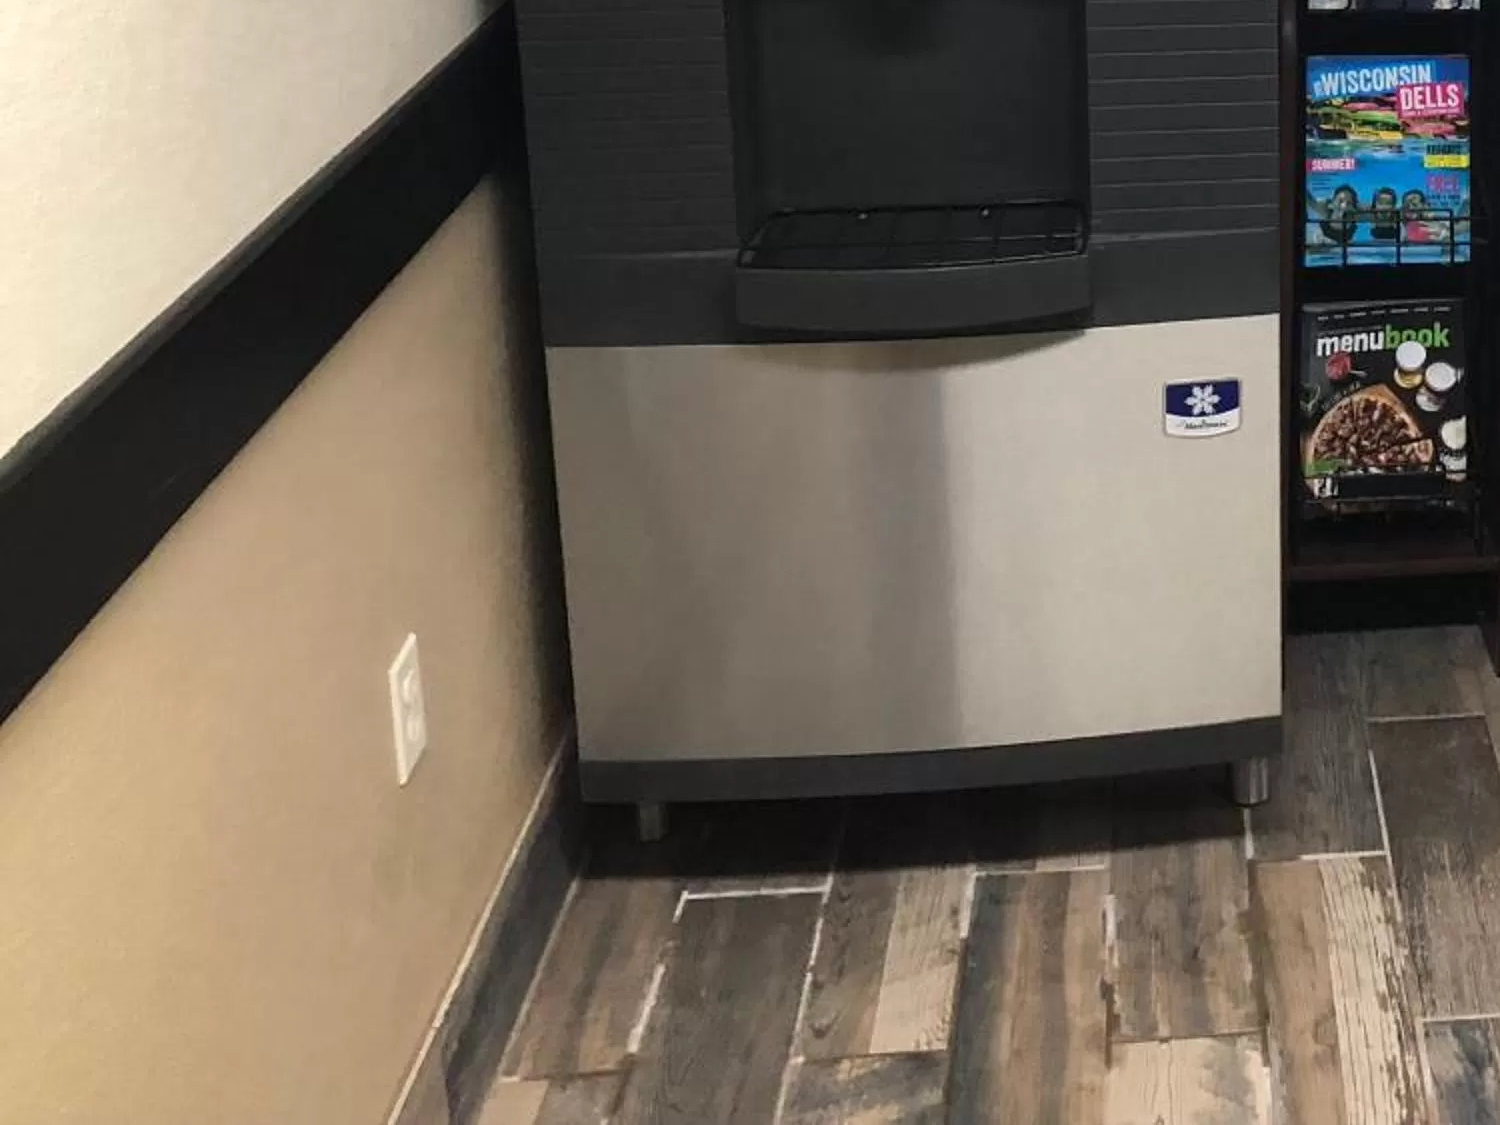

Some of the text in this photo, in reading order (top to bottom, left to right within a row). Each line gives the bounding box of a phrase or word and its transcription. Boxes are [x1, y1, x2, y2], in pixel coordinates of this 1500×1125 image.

[1322, 63, 1432, 96] WISCONSIN
[1400, 84, 1460, 110] DELLS
[1316, 321, 1450, 357] menubook
